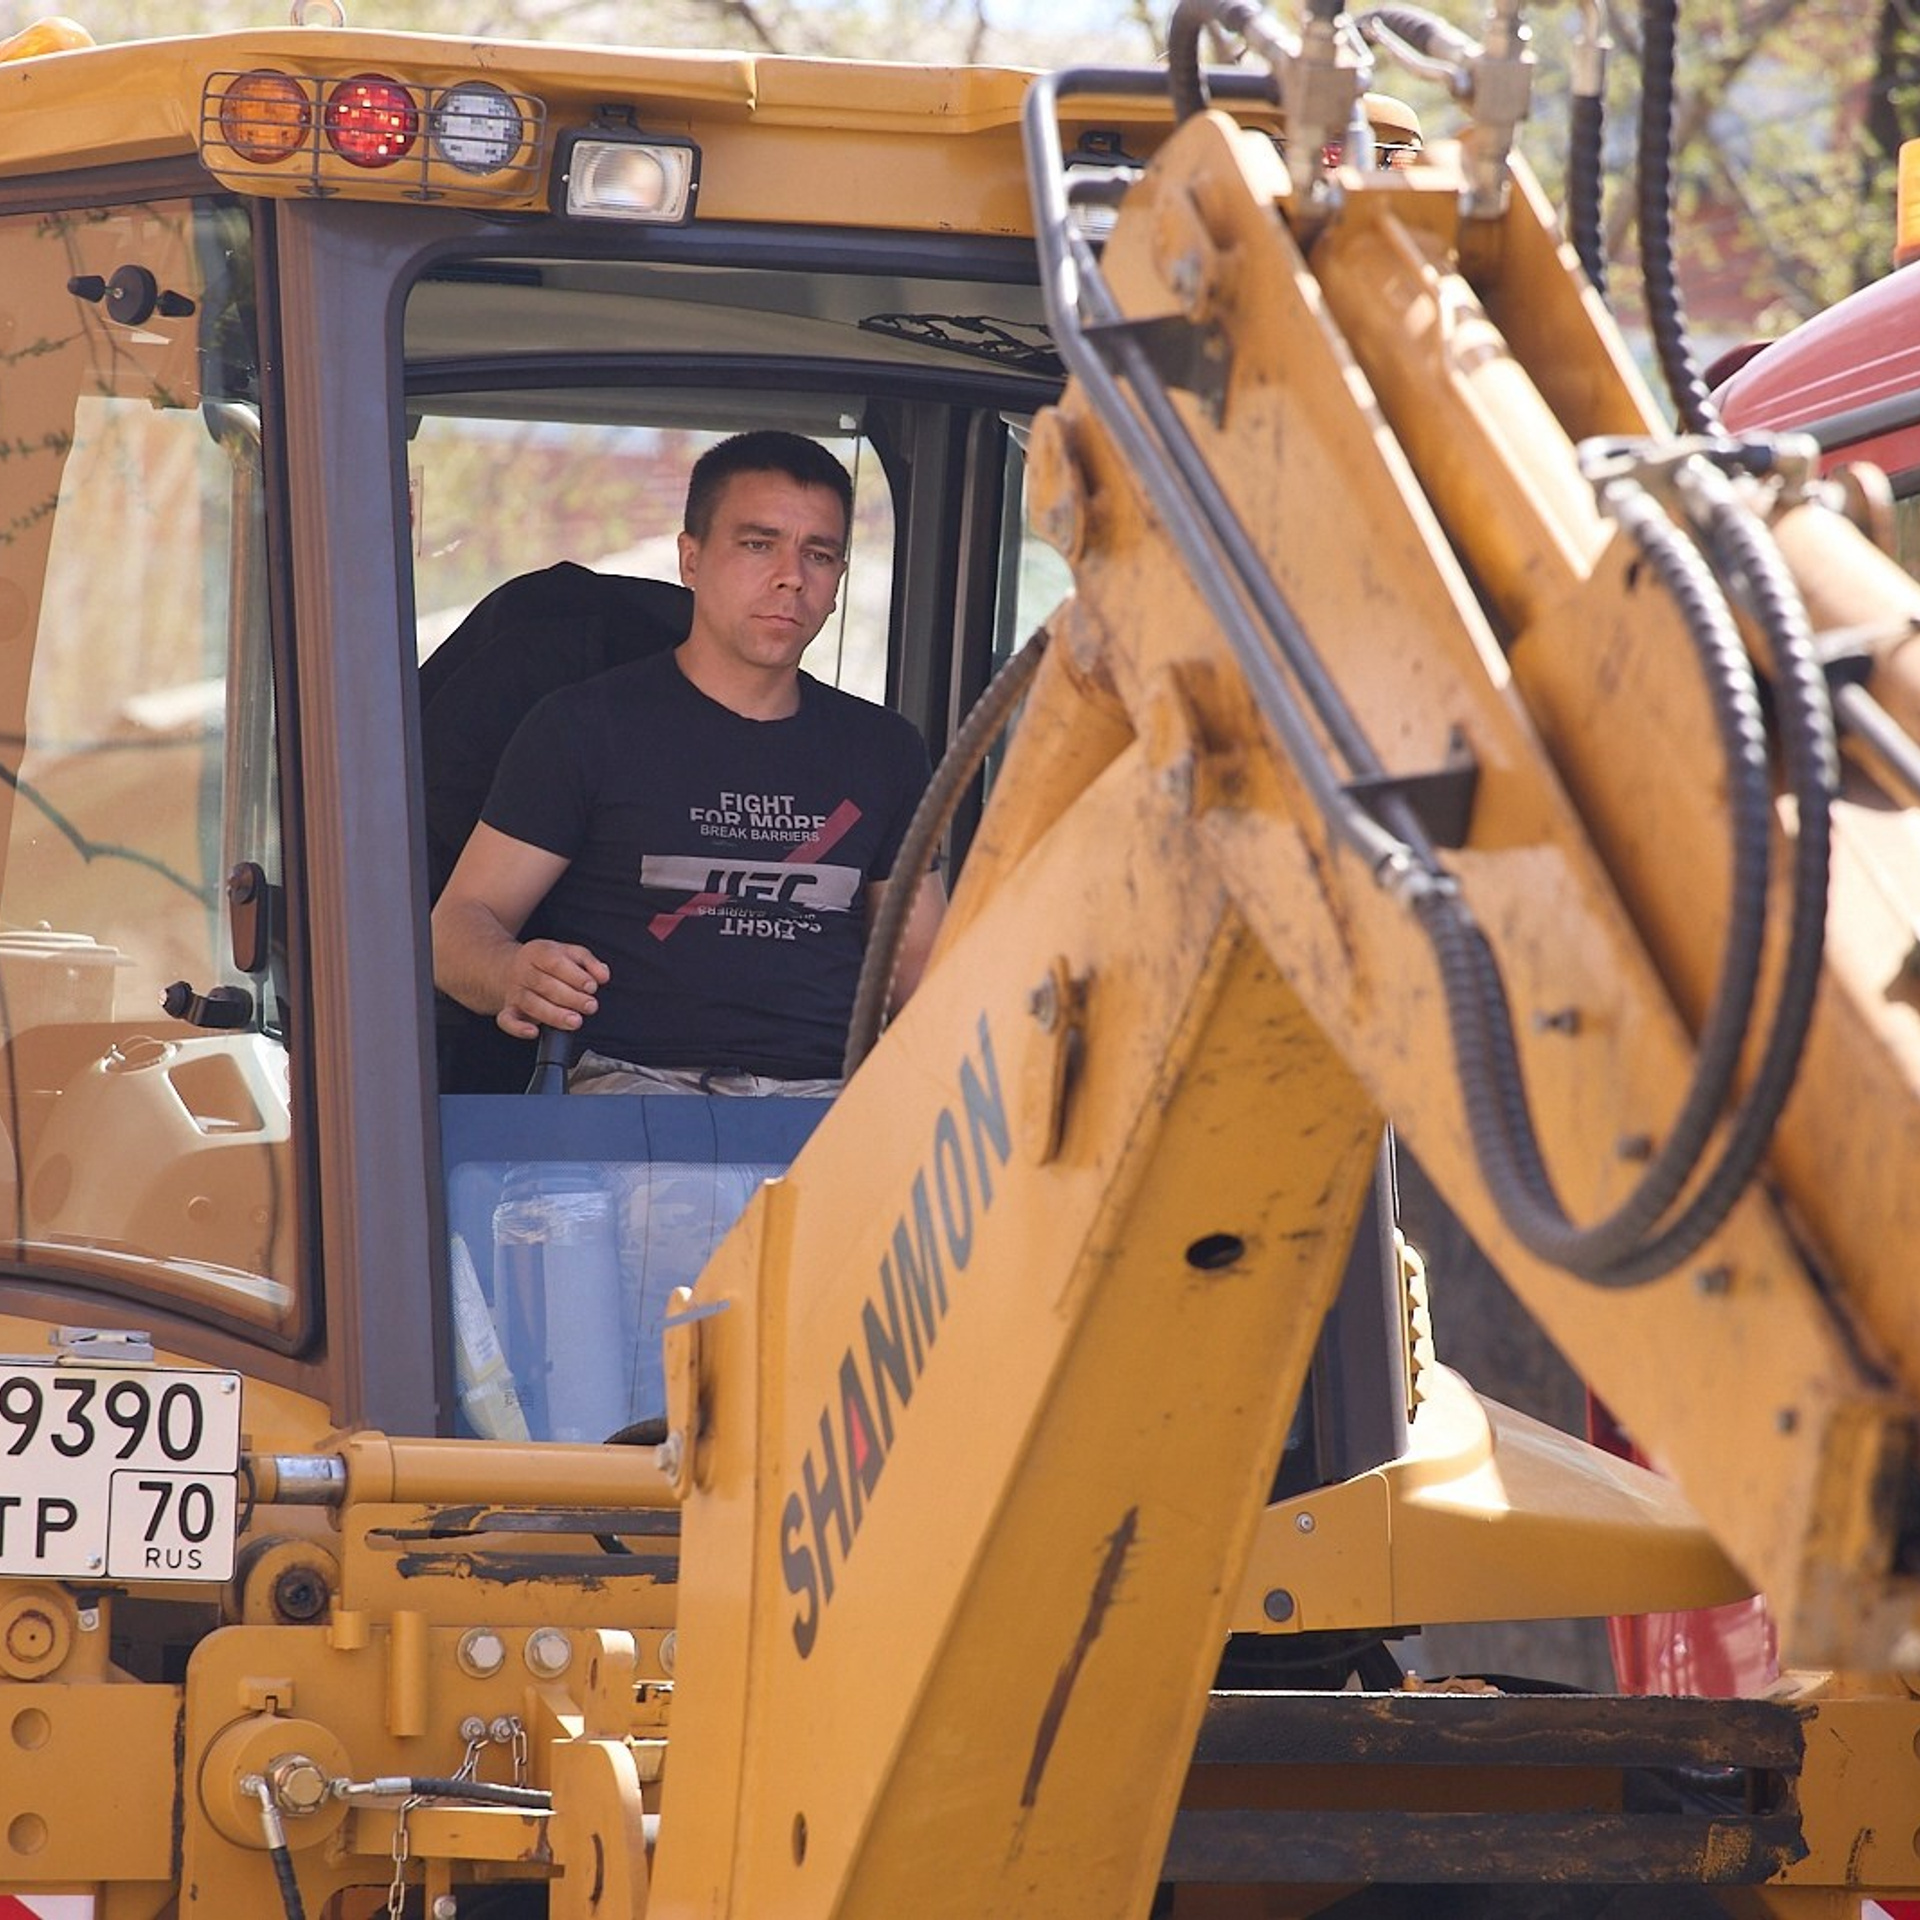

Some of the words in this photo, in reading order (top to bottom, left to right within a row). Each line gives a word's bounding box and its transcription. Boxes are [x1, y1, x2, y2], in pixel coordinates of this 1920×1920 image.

[720, 791, 795, 815] FIGHT
[690, 807, 742, 826] FOR
[750, 814, 826, 829] MORE
[700, 824, 747, 840] BREAK
[751, 829, 820, 842] BARRIERS
[704, 868, 819, 901] UFC
[780, 1010, 1012, 1661] SHANMON
[0, 1376, 203, 1461] 9390
[139, 1481, 214, 1543] 70
[145, 1547, 202, 1570] RUS
